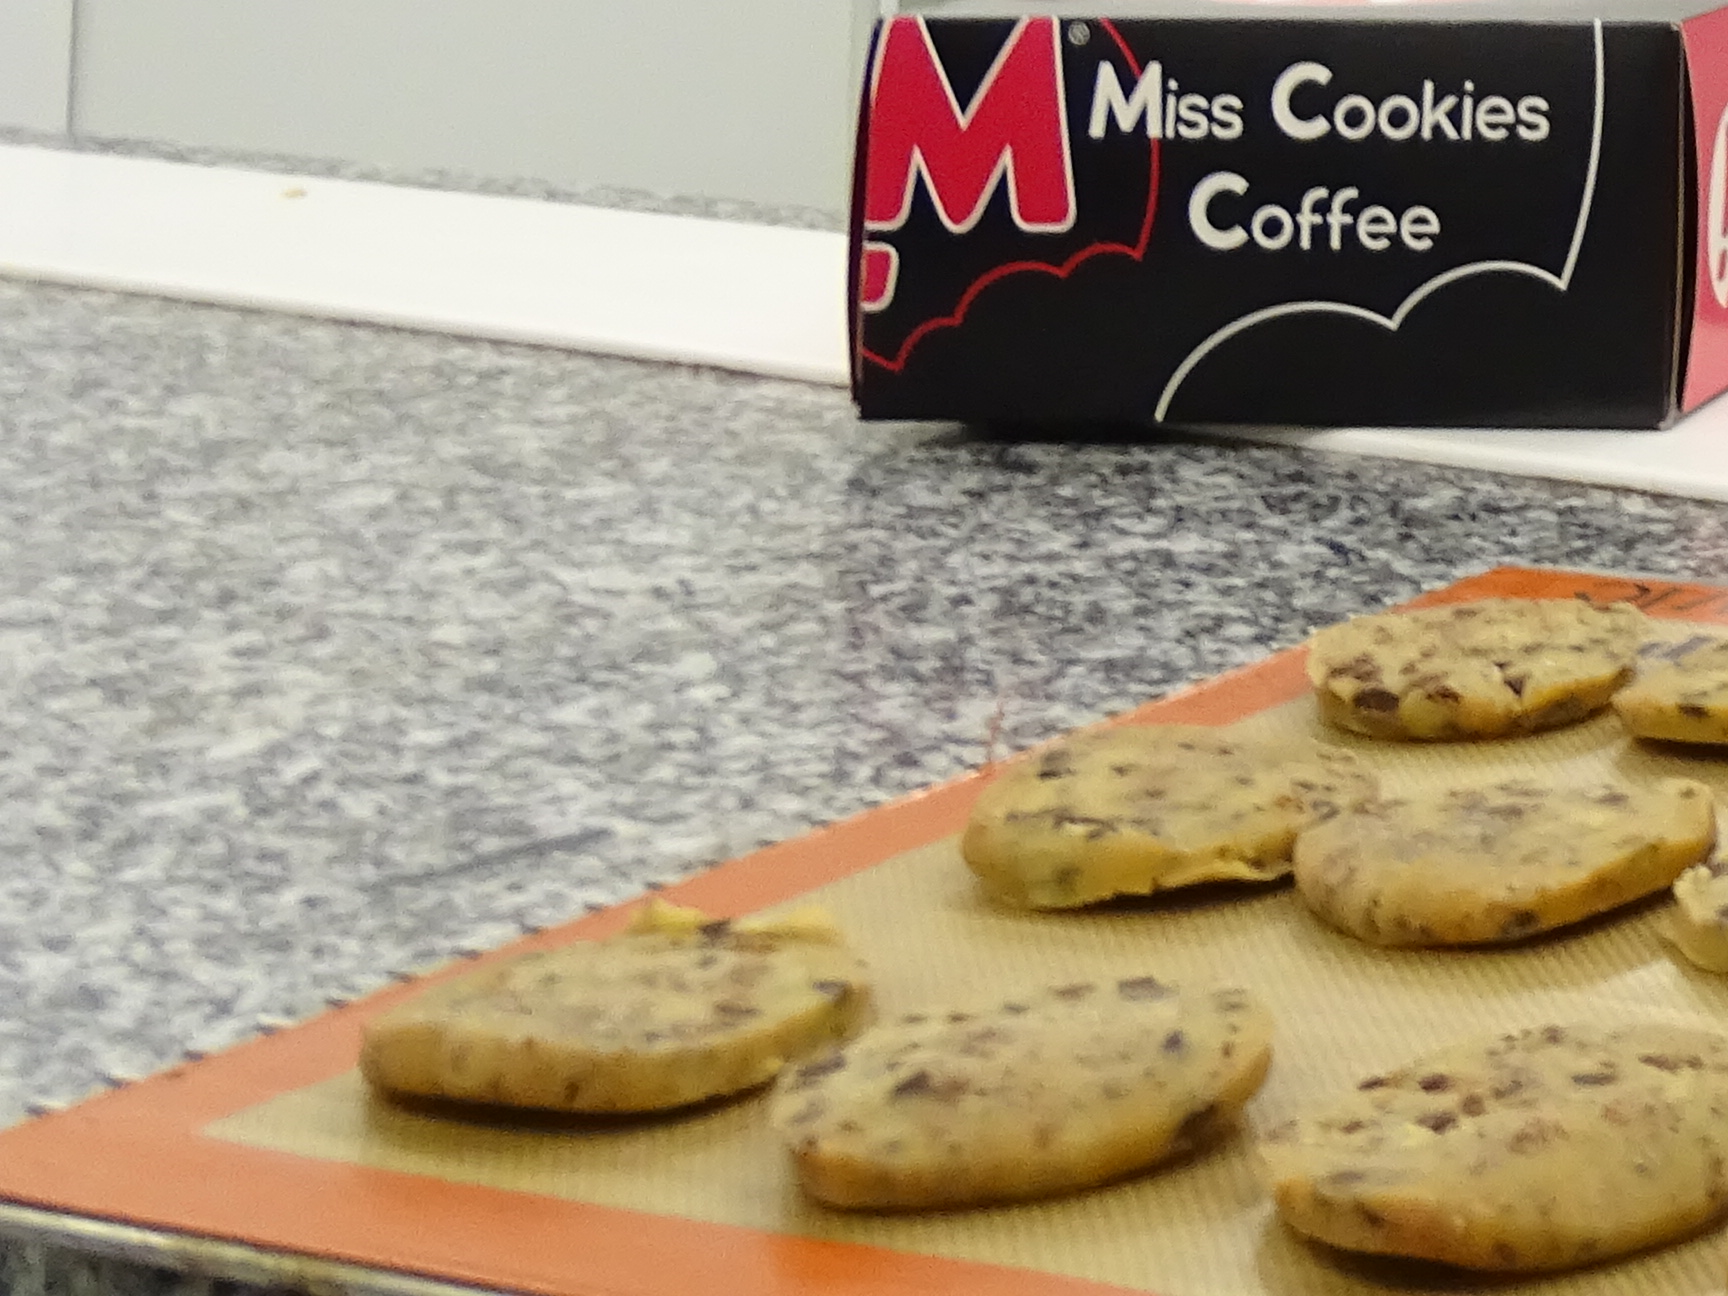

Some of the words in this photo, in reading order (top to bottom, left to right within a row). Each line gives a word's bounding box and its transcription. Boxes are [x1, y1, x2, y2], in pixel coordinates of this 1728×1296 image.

[864, 14, 1077, 234] M
[1088, 59, 1244, 141] Miss
[1270, 60, 1551, 142] Cookies
[1187, 169, 1442, 252] Coffee
